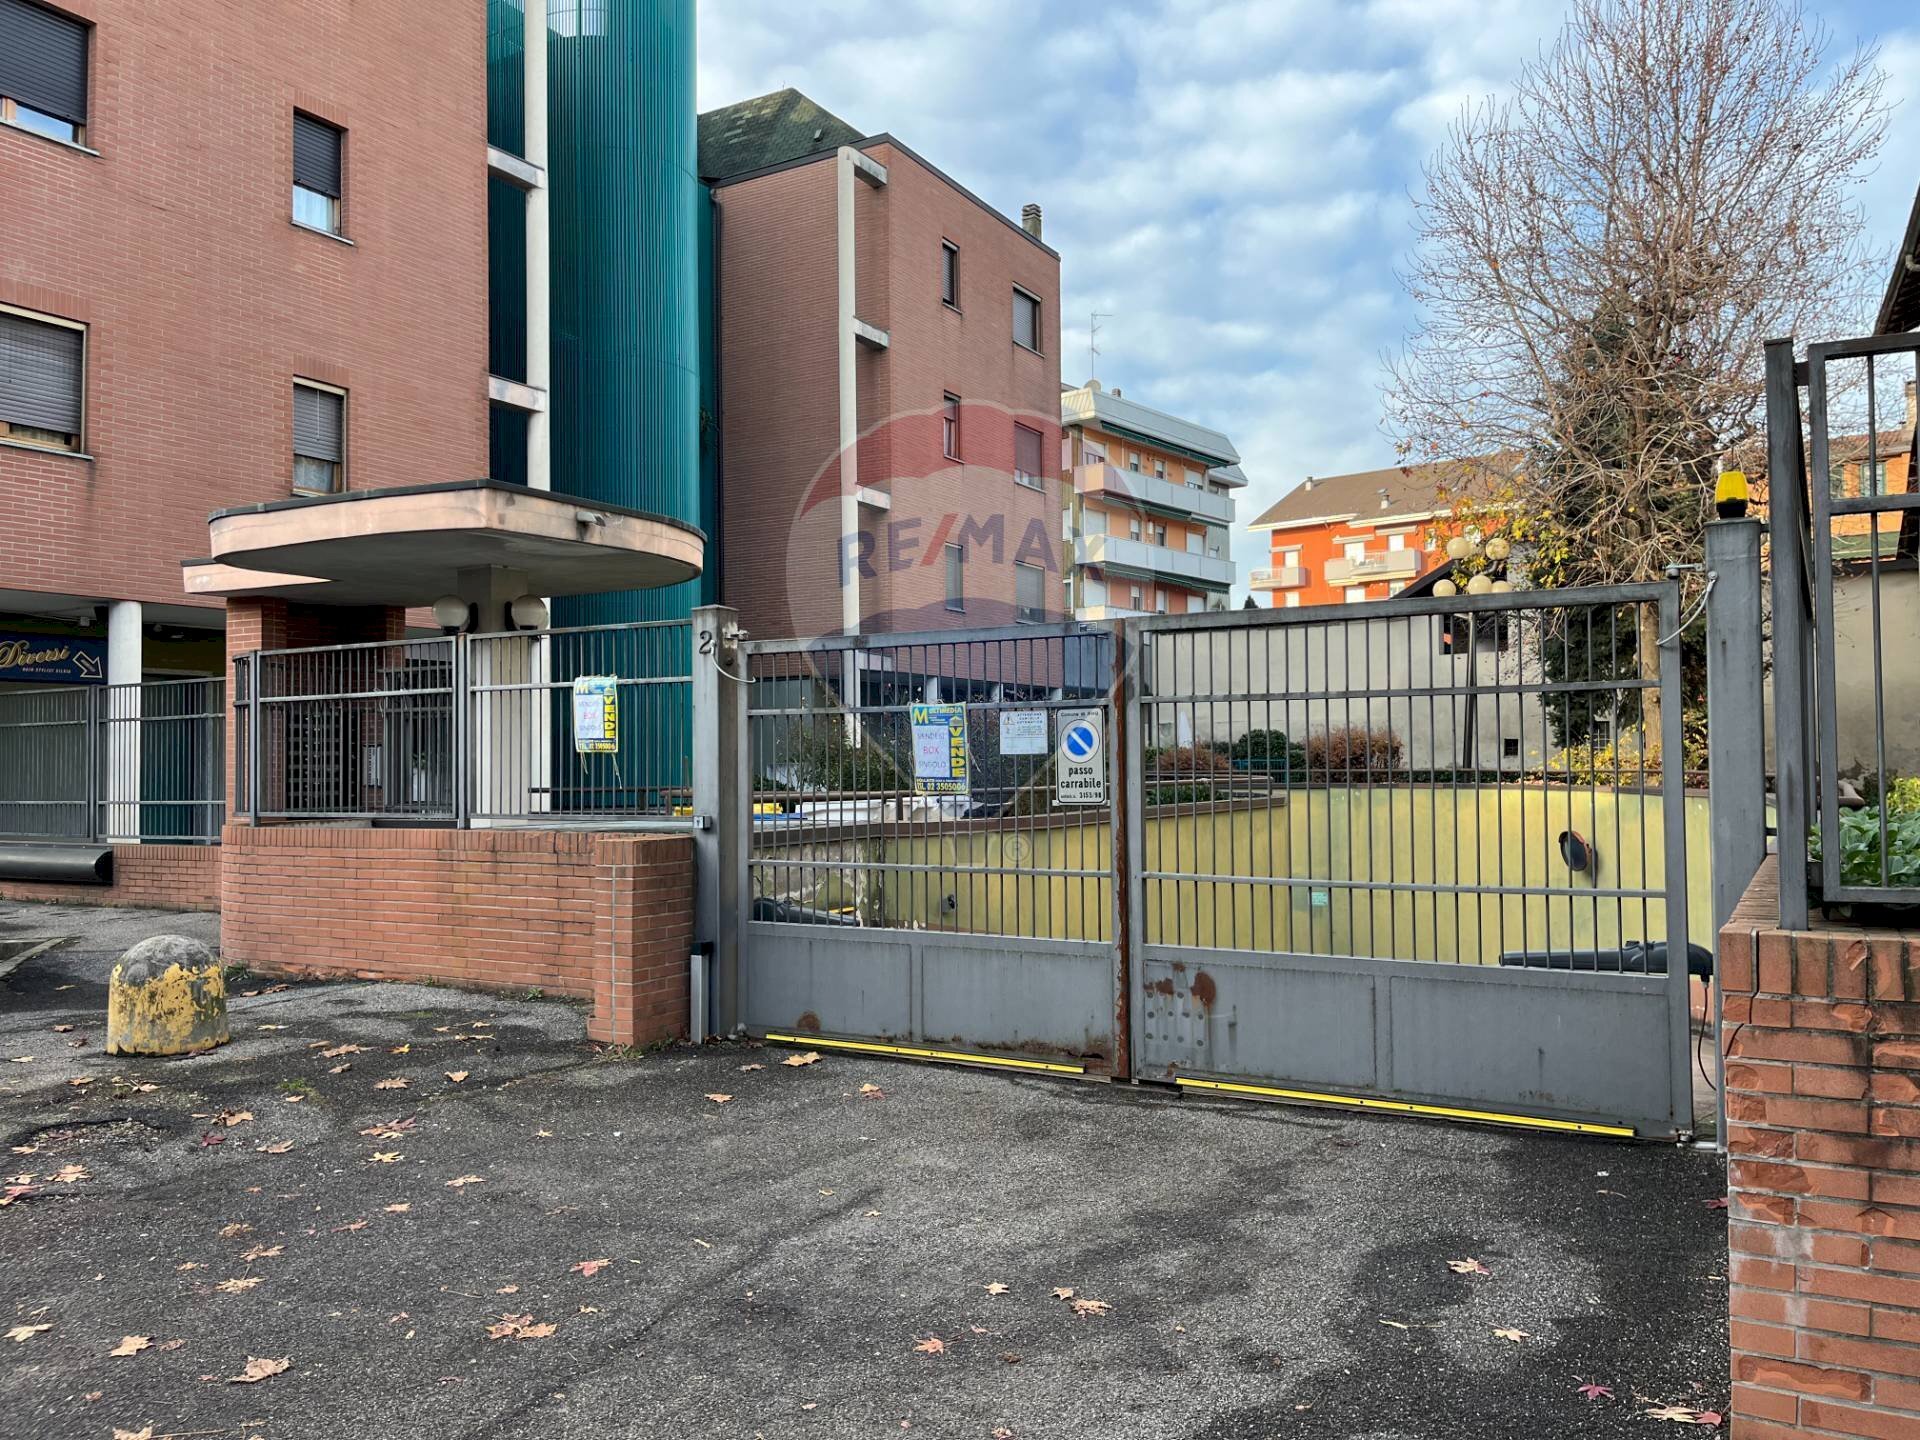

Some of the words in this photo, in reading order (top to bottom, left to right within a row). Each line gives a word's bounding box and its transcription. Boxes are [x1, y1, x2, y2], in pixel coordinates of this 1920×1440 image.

[699, 630, 713, 655] 2
[603, 695, 616, 738] VENDE
[923, 746, 940, 754] BOX
[949, 726, 967, 778] VENDE
[1068, 766, 1094, 777] passo
[1060, 778, 1102, 789] carrabile
